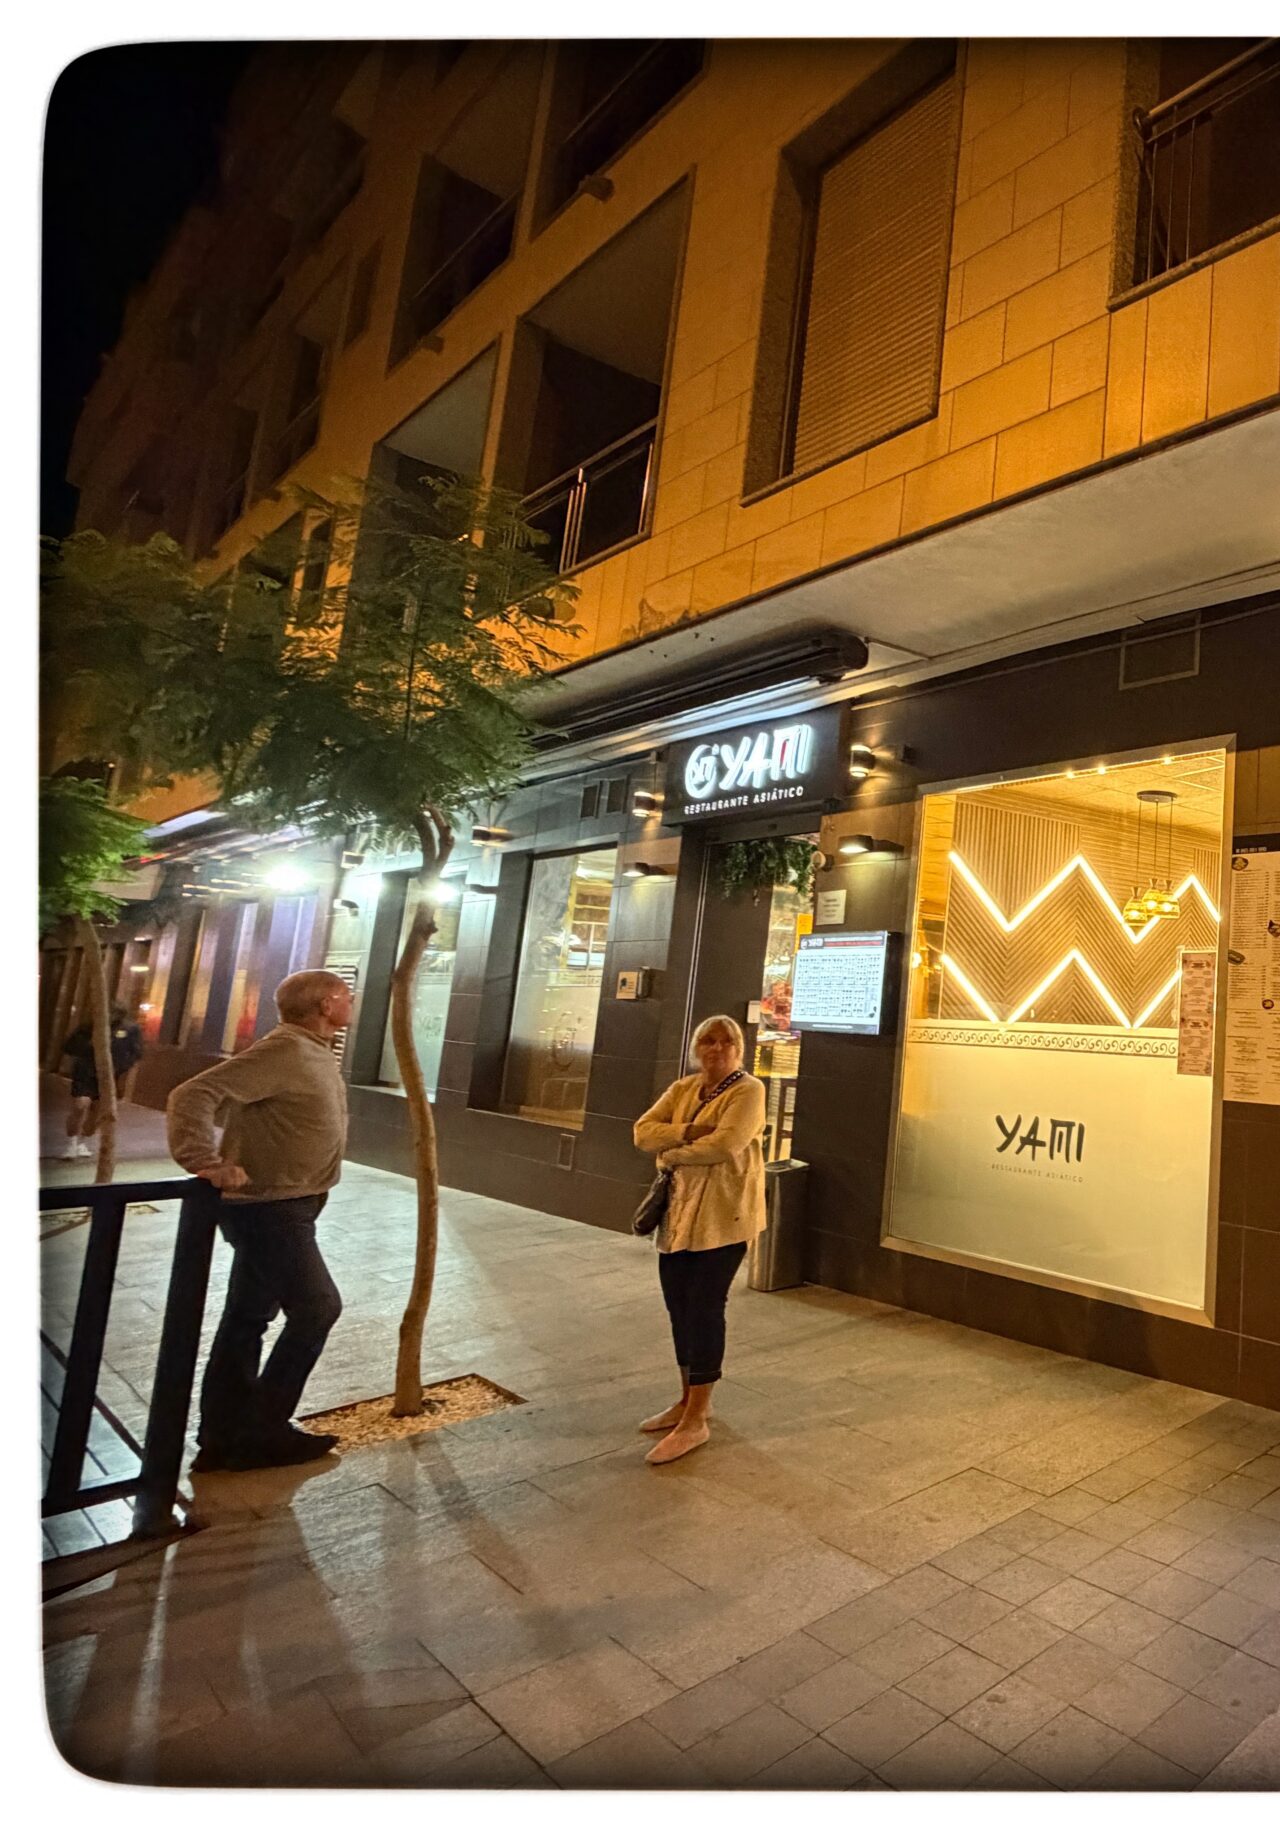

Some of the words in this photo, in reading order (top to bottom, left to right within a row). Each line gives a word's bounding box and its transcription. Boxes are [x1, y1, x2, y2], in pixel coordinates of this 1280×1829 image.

[684, 795, 749, 815] RESTAURANTE
[752, 786, 804, 804] ASIÁTICO
[995, 1114, 1085, 1163] YAMI
